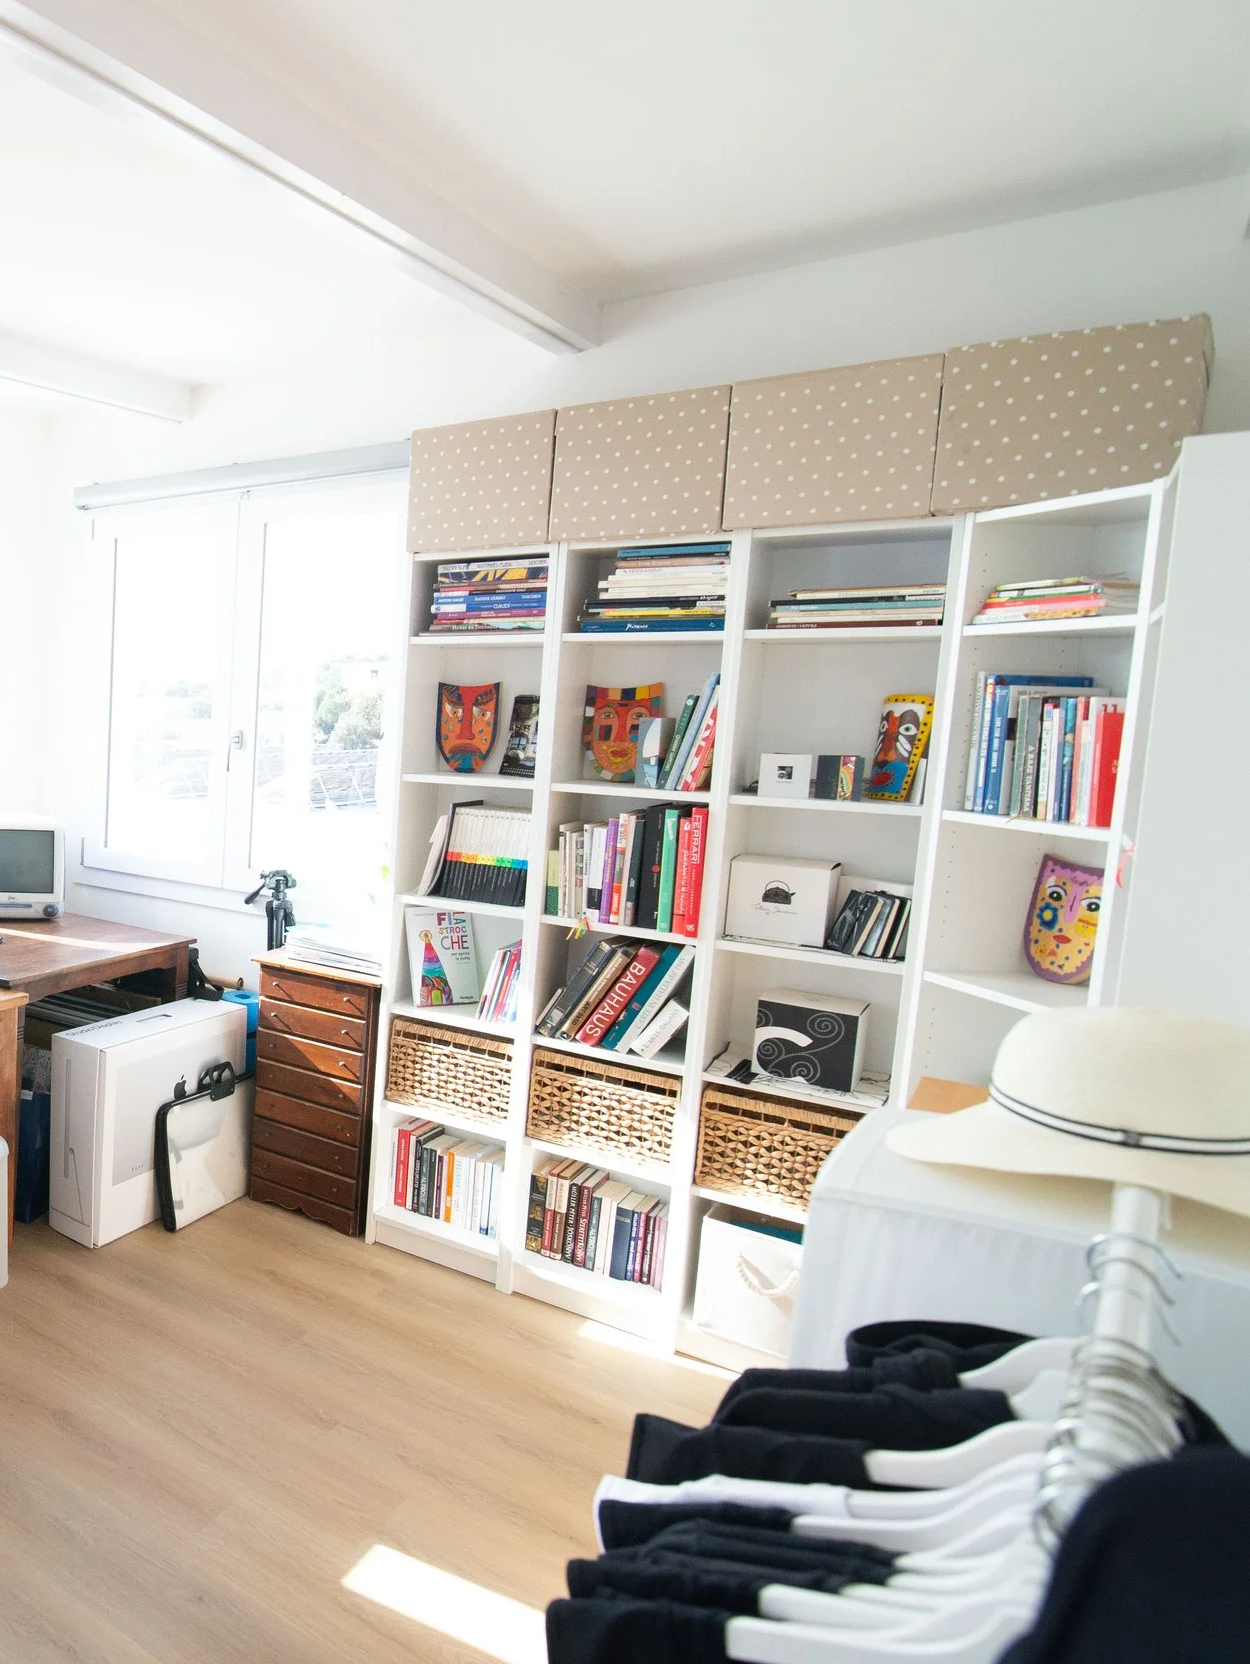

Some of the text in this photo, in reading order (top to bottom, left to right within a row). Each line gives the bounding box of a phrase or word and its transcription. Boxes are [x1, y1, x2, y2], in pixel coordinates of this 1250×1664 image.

[691, 815, 703, 864] FERRARI
[439, 926, 467, 935] STROC
[440, 935, 469, 950] CHE
[586, 961, 646, 1037] BAUHAUS
[569, 1186, 577, 1207] MÜLLER
